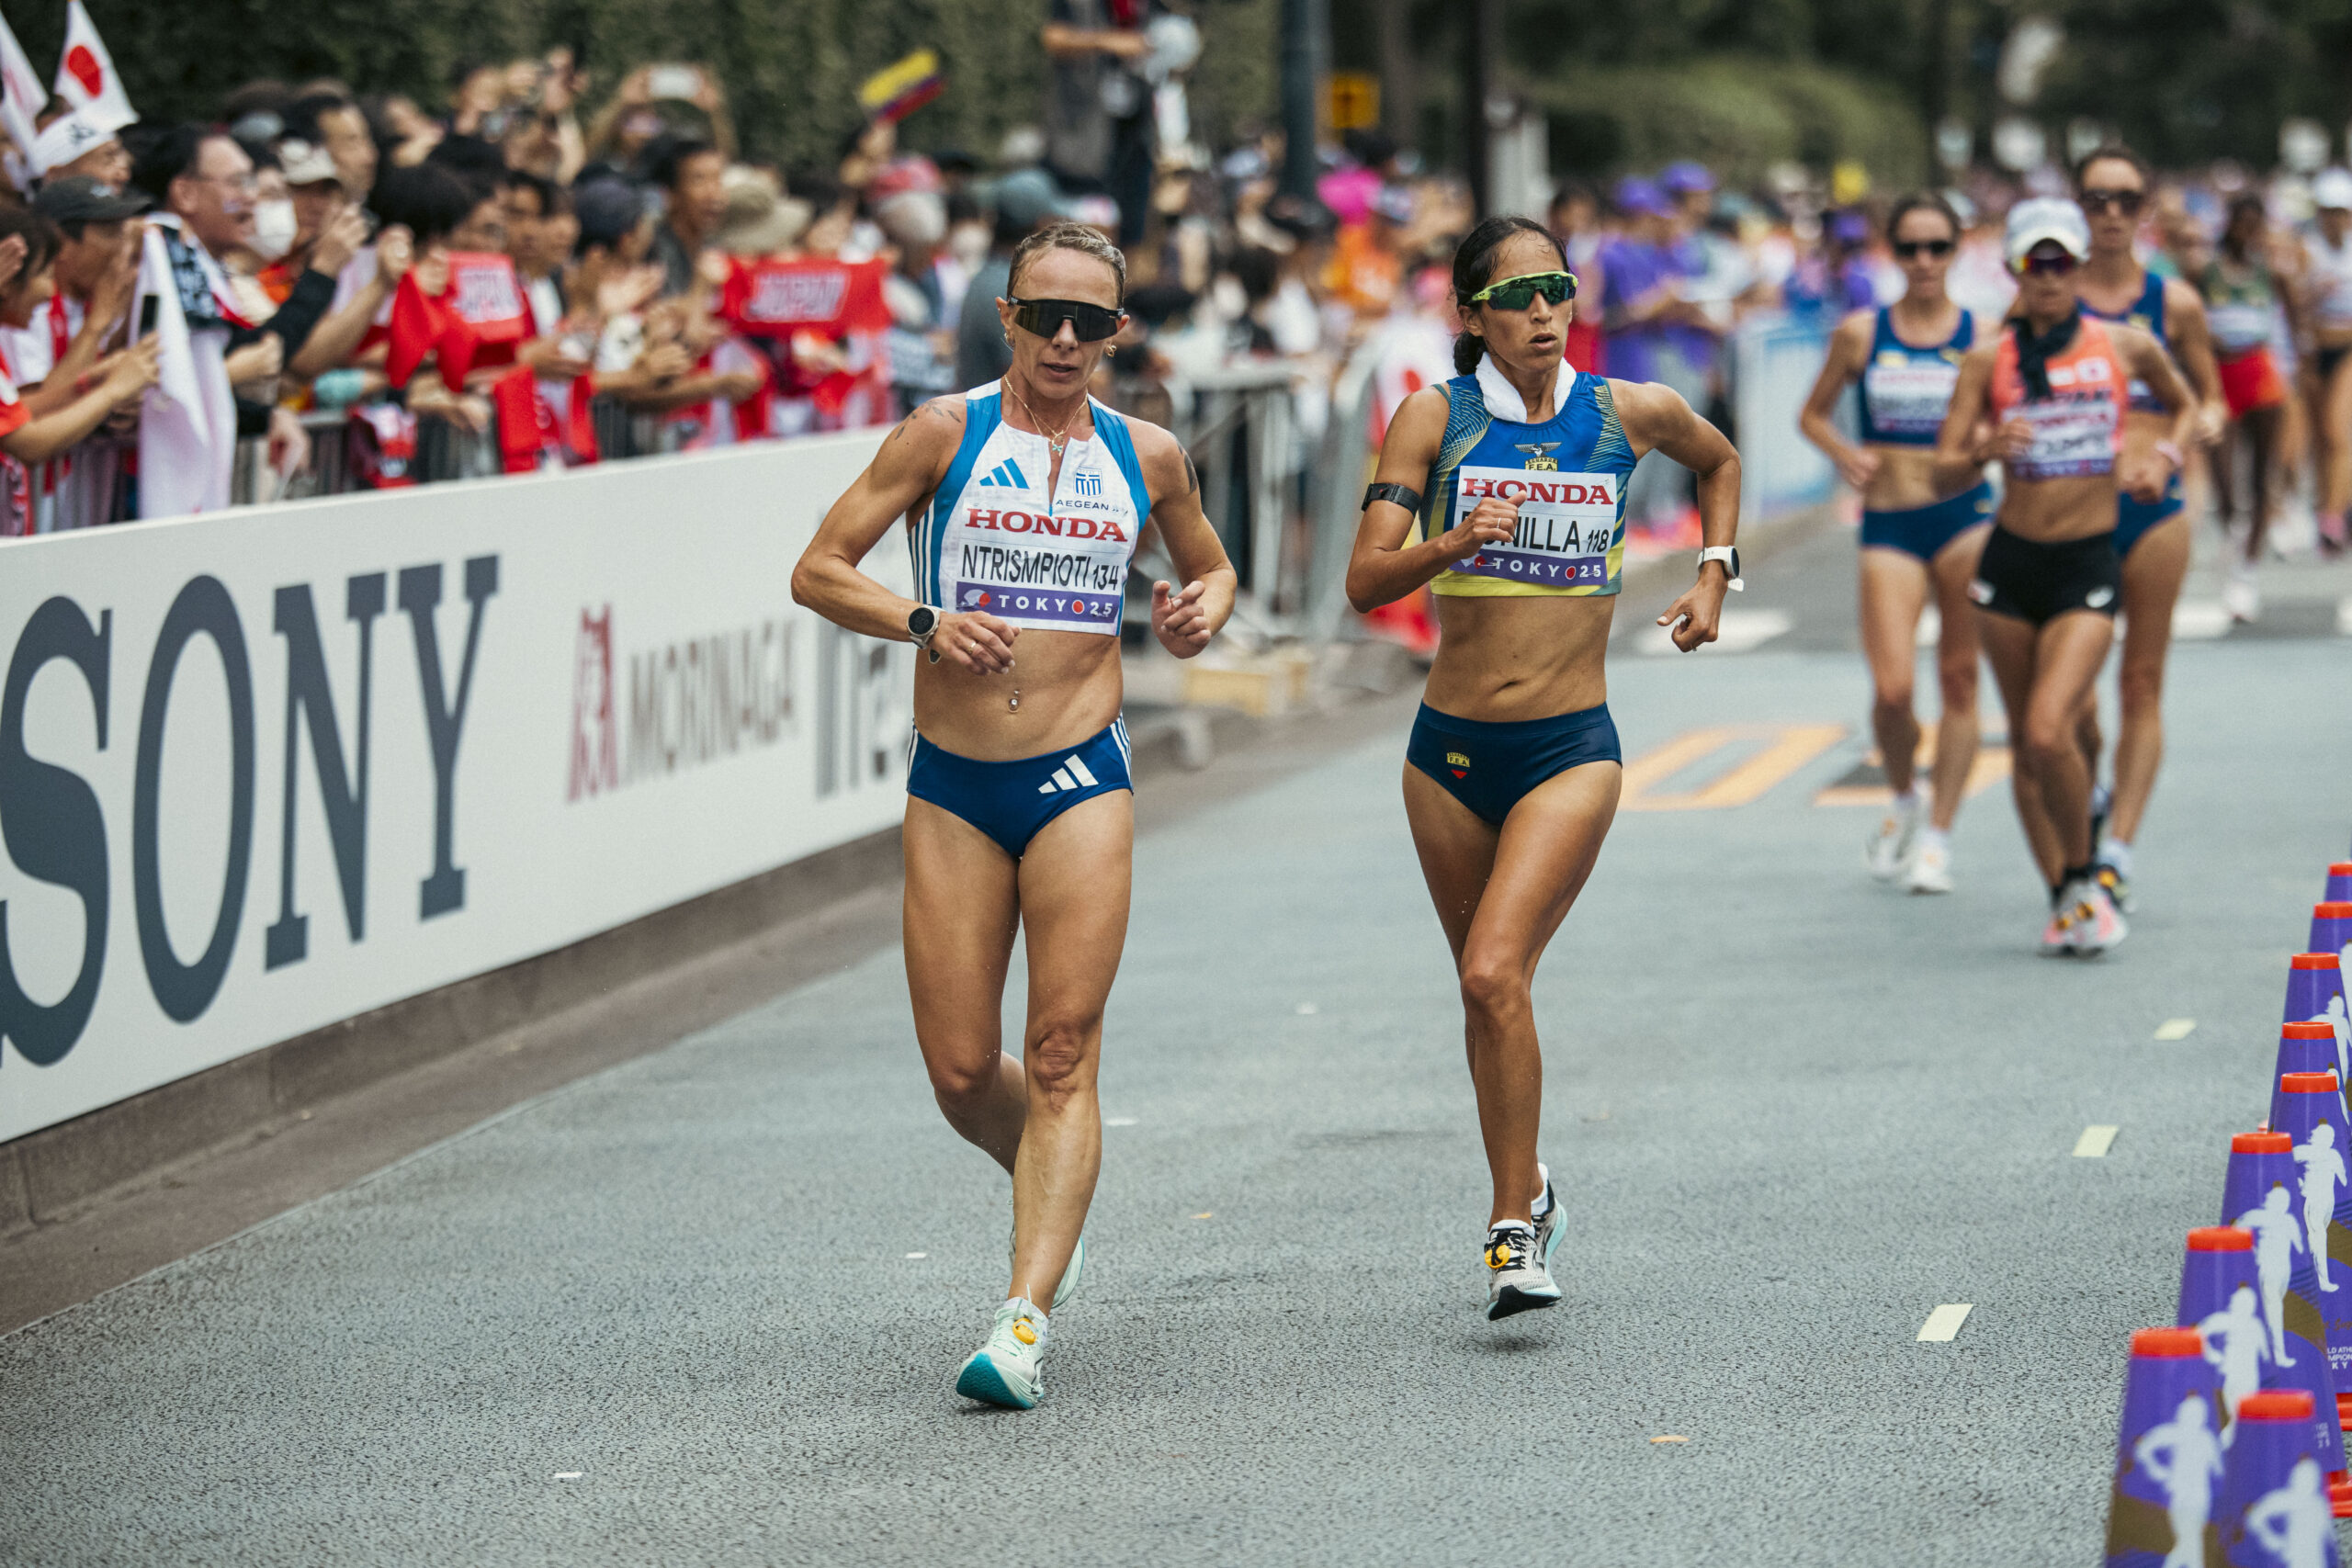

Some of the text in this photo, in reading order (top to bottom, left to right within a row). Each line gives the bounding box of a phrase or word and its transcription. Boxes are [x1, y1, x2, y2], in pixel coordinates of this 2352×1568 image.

[1056, 500, 1109, 511] AEGEAN
[1461, 478, 1614, 505] HONDA
[965, 508, 1128, 542] HONDA
[1462, 511, 1609, 553] NILLA 118
[961, 544, 1119, 591] NTRISMPIOTI 134
[1579, 565, 1601, 578] 25
[1090, 602, 1113, 615] 25
[0, 555, 499, 1067] SONY
